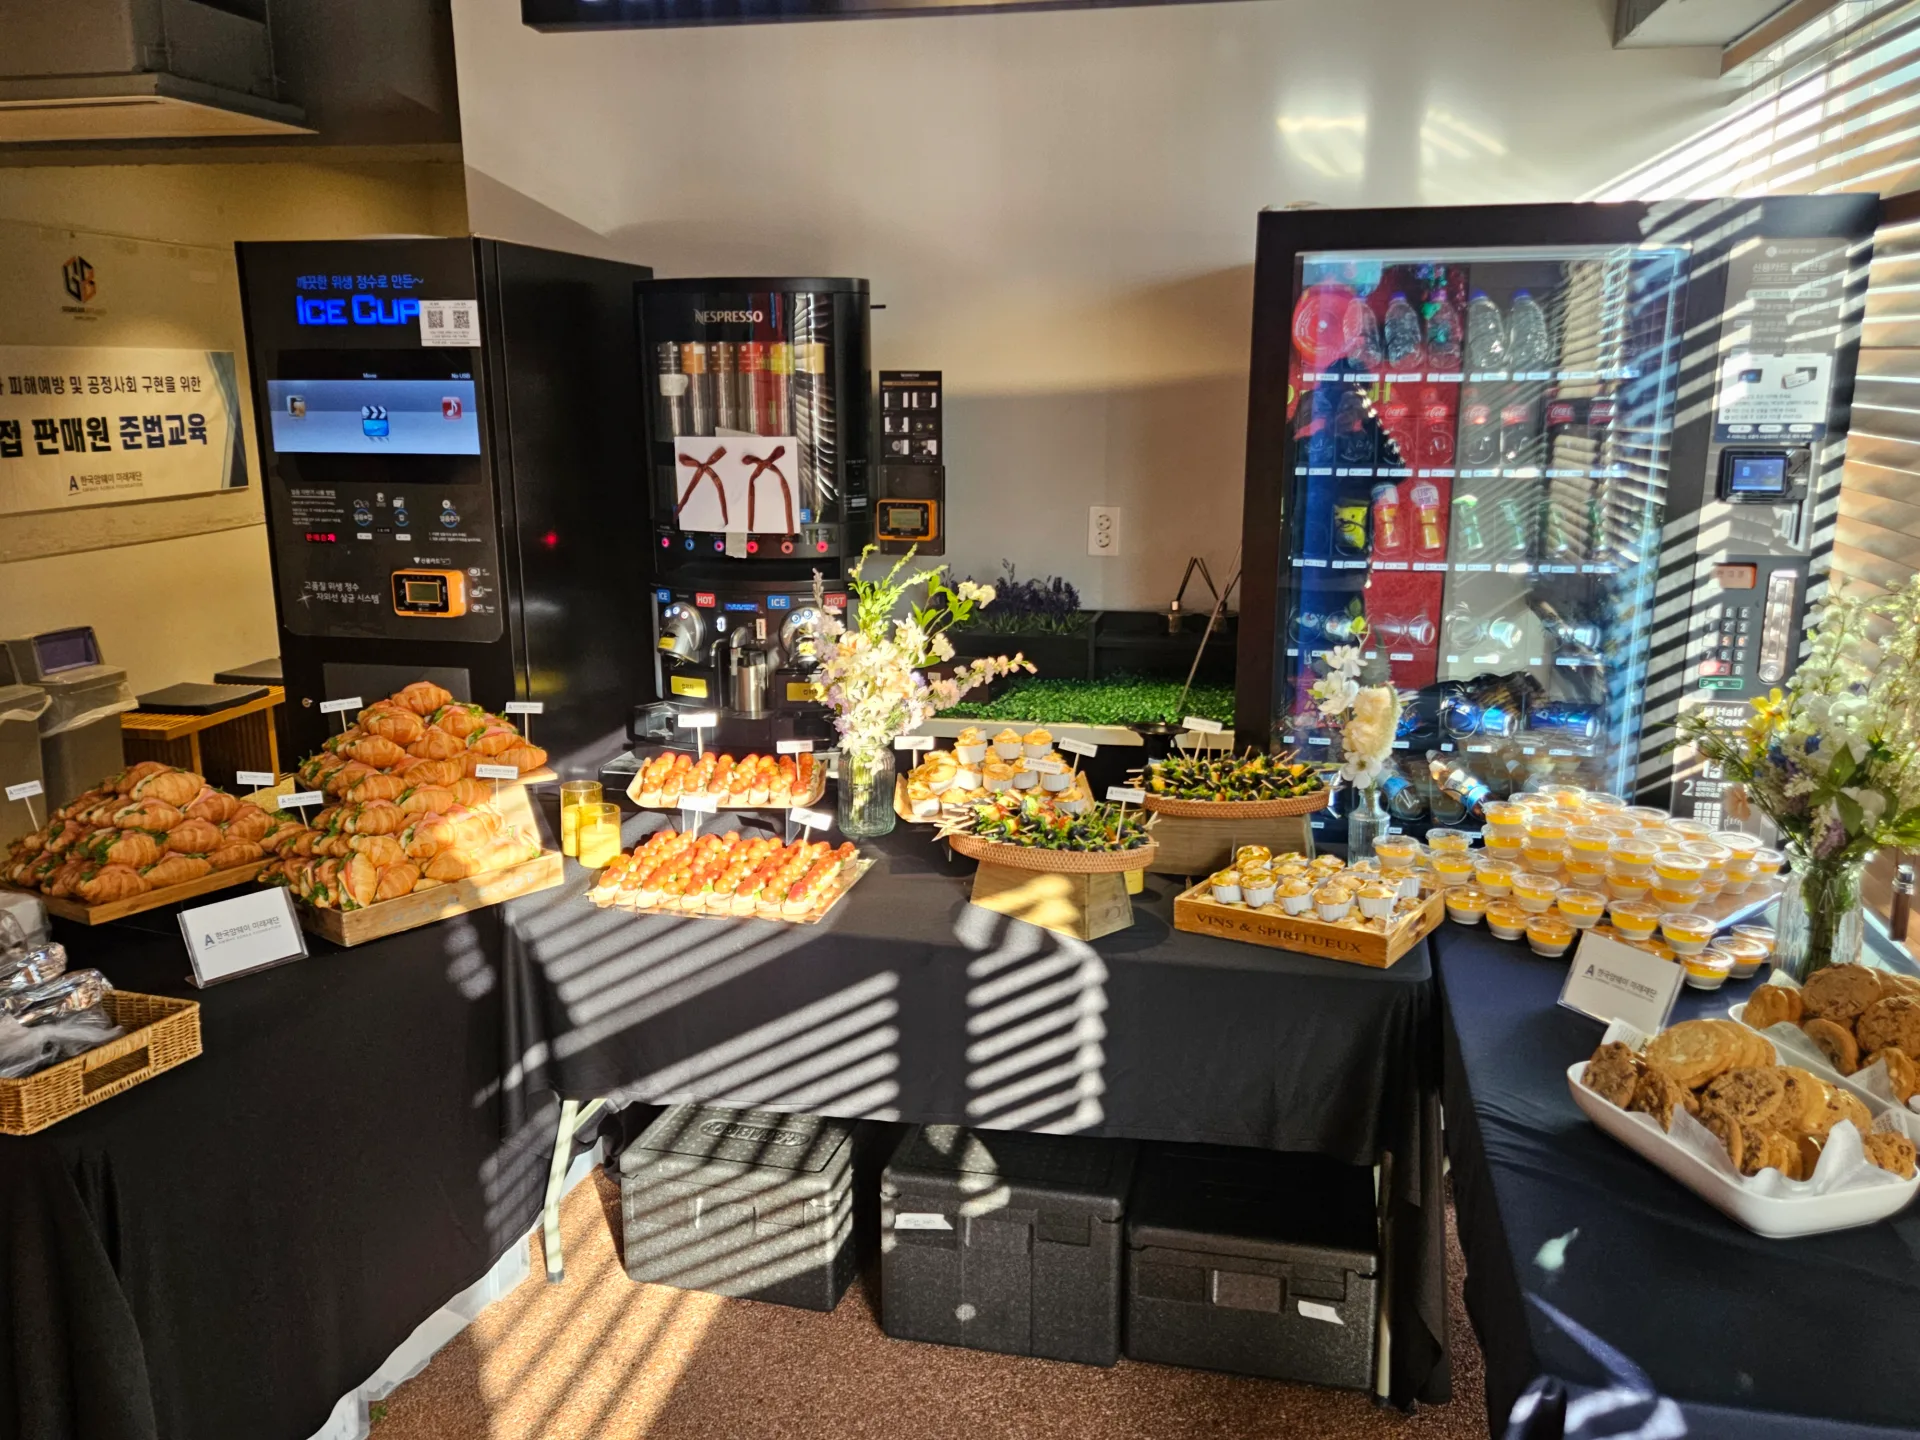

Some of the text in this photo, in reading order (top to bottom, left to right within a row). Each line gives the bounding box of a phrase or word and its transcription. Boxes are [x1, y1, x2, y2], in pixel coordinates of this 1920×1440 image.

[331, 275, 353, 289] 위생
[356, 275, 389, 289] 정수로
[694, 309, 763, 324] NESPRESSO
[8, 376, 65, 396] 피해예방
[69, 376, 83, 395] 및
[87, 375, 138, 395] 공정사회
[141, 375, 177, 394] 구현을
[180, 375, 202, 394] 위한
[32, 416, 112, 455] 판매원
[119, 413, 208, 450] 준법교육
[69, 475, 79, 491] A
[304, 581, 360, 592] 고품질 위생 정수
[357, 594, 380, 605] 시스템
[658, 592, 668, 600] ICE
[697, 596, 713, 605] HOT
[771, 598, 786, 607] ICE
[826, 598, 844, 606] HOT
[1716, 707, 1744, 717] Half
[1681, 780, 1695, 797] 2
[215, 916, 280, 940] 한국암웨이 미래재단
[1195, 913, 1362, 954] VINS & SPIRITUEUX
[205, 934, 215, 947] A
[1585, 964, 1595, 977] A
